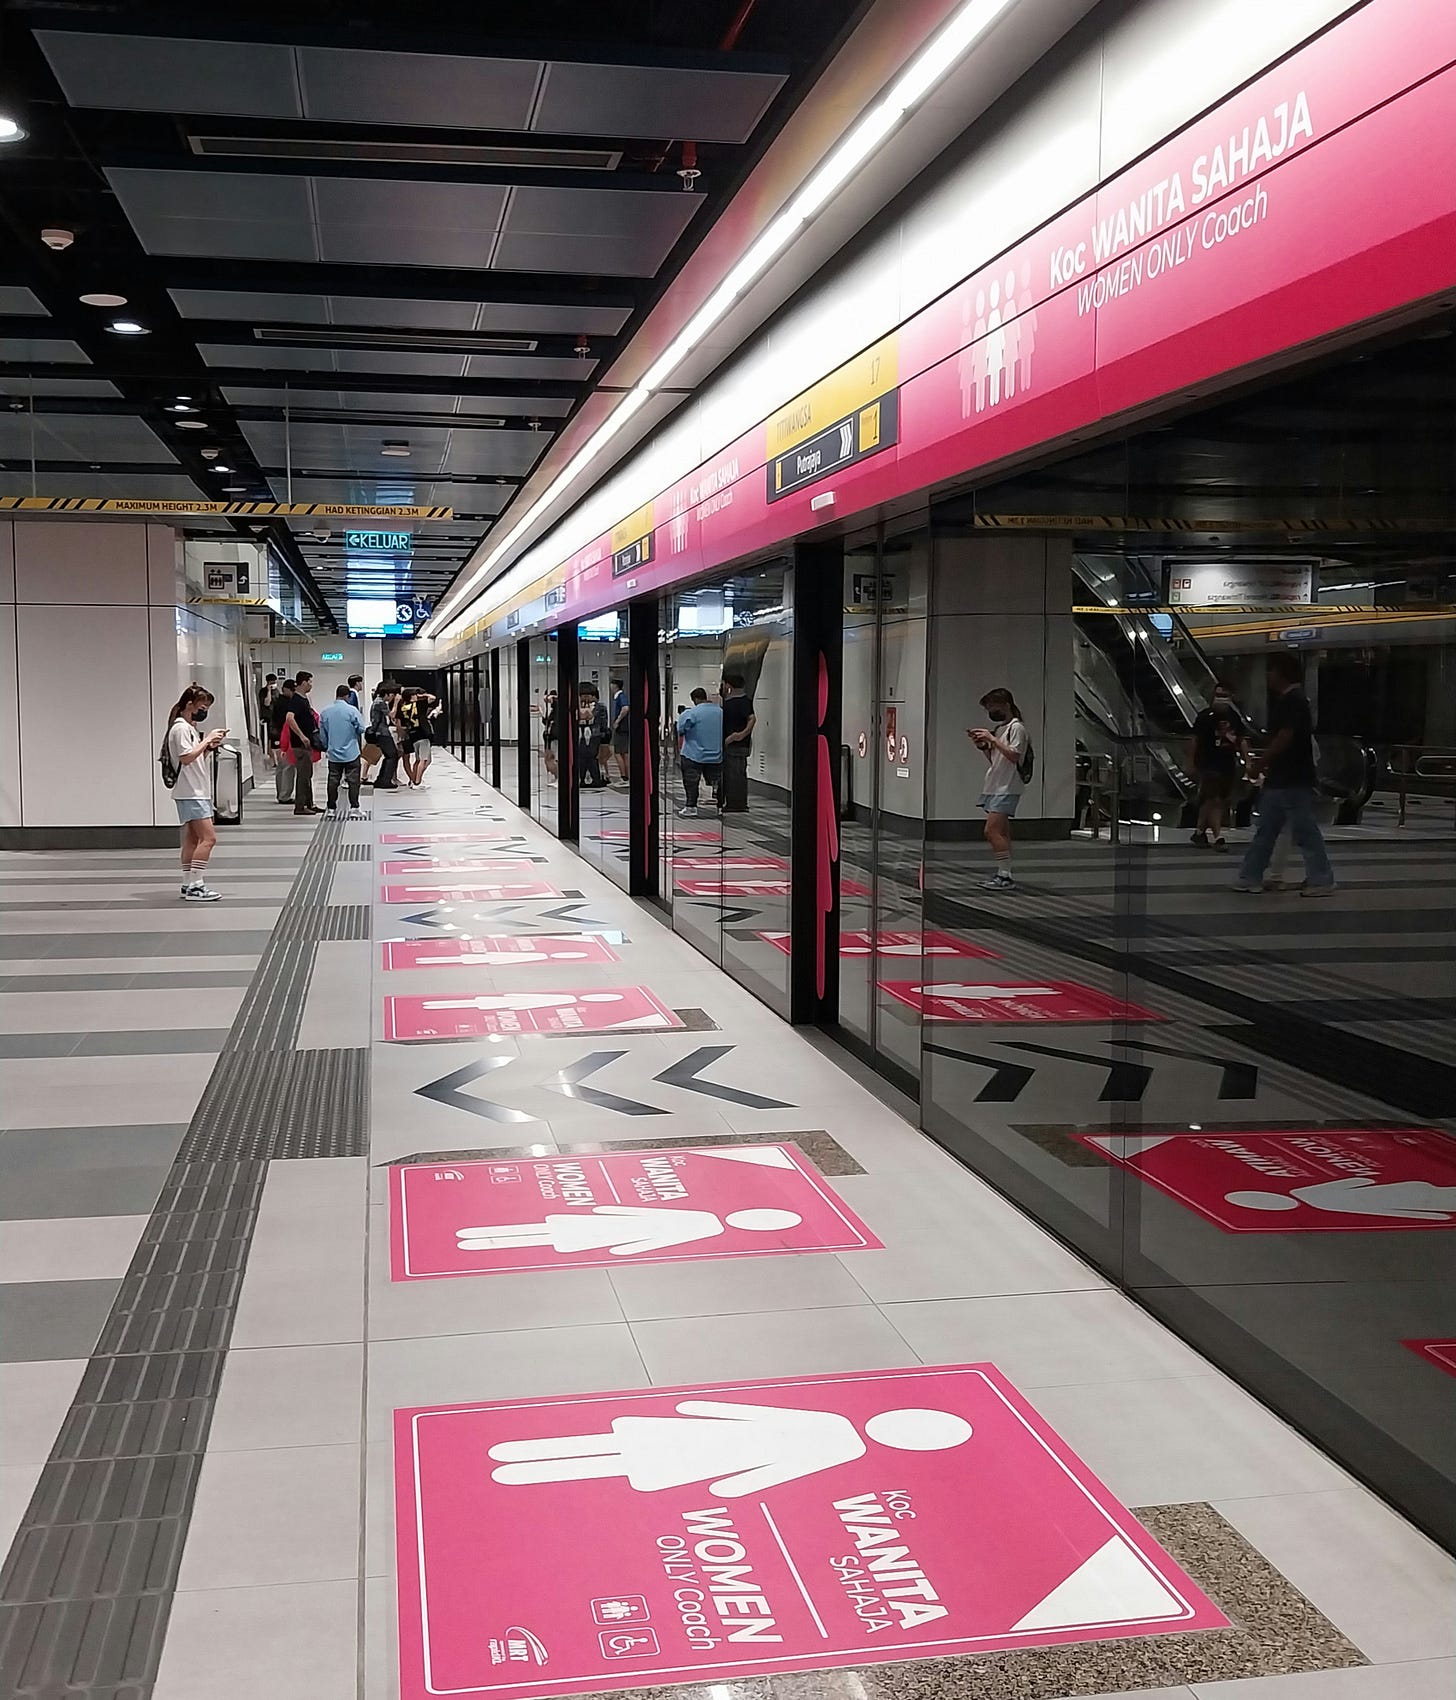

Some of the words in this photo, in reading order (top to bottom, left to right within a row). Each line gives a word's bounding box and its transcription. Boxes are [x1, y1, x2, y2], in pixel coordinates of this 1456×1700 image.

[1049, 241, 1086, 290] Koc
[1091, 172, 1185, 264] WANITA
[1191, 90, 1314, 205] SAHAJA
[1077, 253, 1143, 317] WOMEN
[1147, 221, 1198, 279] ONLY
[1201, 183, 1267, 249] Coach
[871, 356, 880, 385] 17
[797, 448, 821, 475] Putrajaya
[115, 502, 160, 510] MAXIMUM
[162, 502, 194, 511] HEIGHT
[196, 503, 218, 511] 2.3M
[325, 506, 343, 514] HAD
[346, 506, 396, 515] KETINGGIAN
[398, 507, 419, 515] 2.3M
[360, 534, 408, 549] KELUAR
[552, 1162, 597, 1206] WOMEN
[640, 1156, 689, 1201] WANITA
[881, 1489, 917, 1520] Koc
[656, 1535, 700, 1584] ONLY
[681, 1506, 784, 1643] WOMEN
[832, 1492, 949, 1630] WANITA
[829, 1555, 894, 1634] SAHAJA
[673, 1588, 722, 1650] Coach
[508, 1639, 529, 1661] MRT
